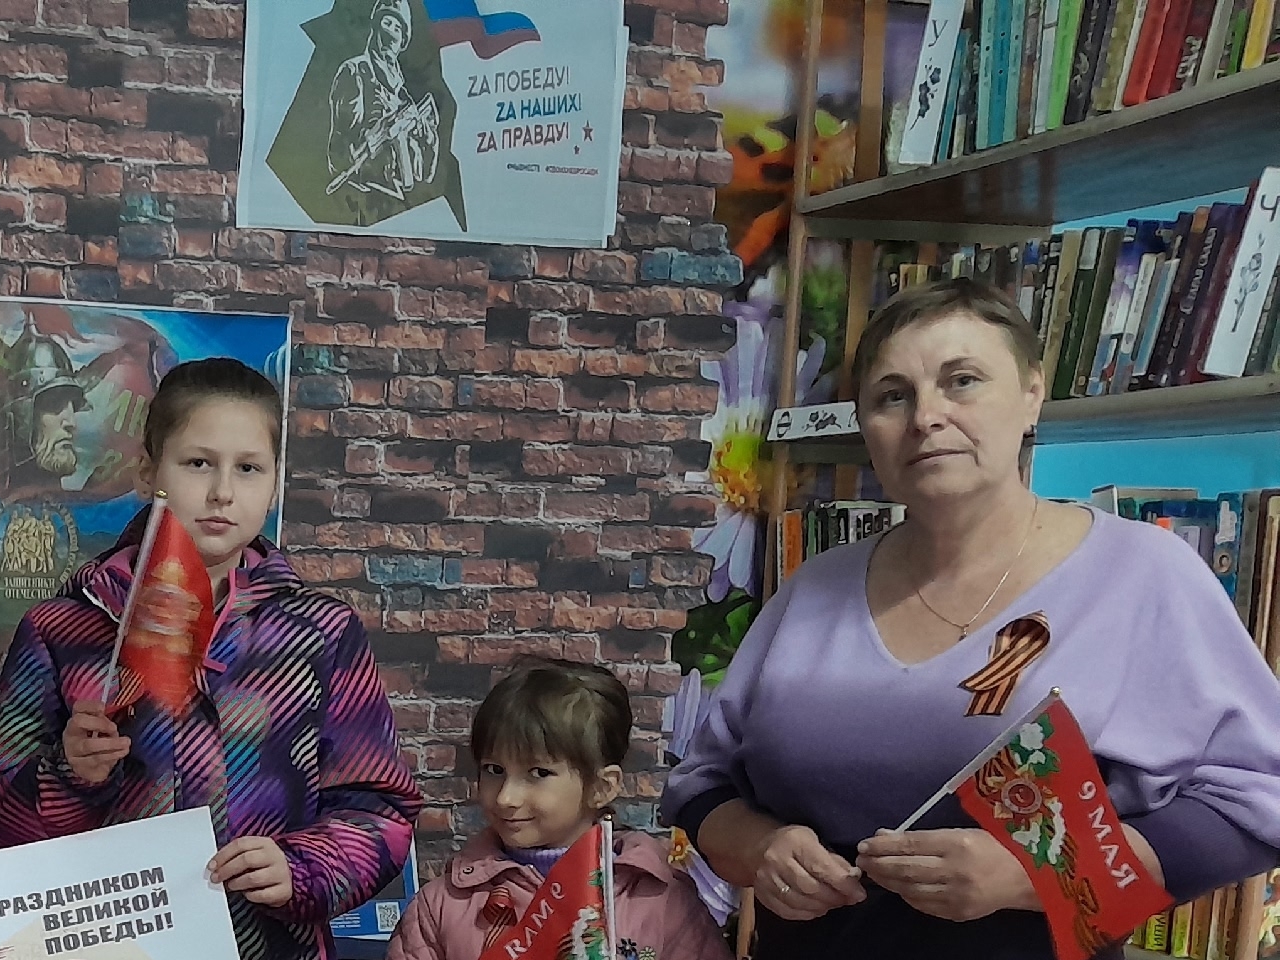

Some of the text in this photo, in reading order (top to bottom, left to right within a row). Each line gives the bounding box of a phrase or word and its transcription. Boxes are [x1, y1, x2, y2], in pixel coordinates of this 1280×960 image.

[495, 66, 569, 93] ПОБЕДУ!
[521, 93, 582, 119] НАШИХ!
[502, 122, 569, 149] ПРАВДУ!
[1078, 781, 1140, 889] 9 МАЯ
[42, 888, 170, 932] ВЕЛИКОЙ
[44, 912, 174, 956] ПОБЕДЫ!
